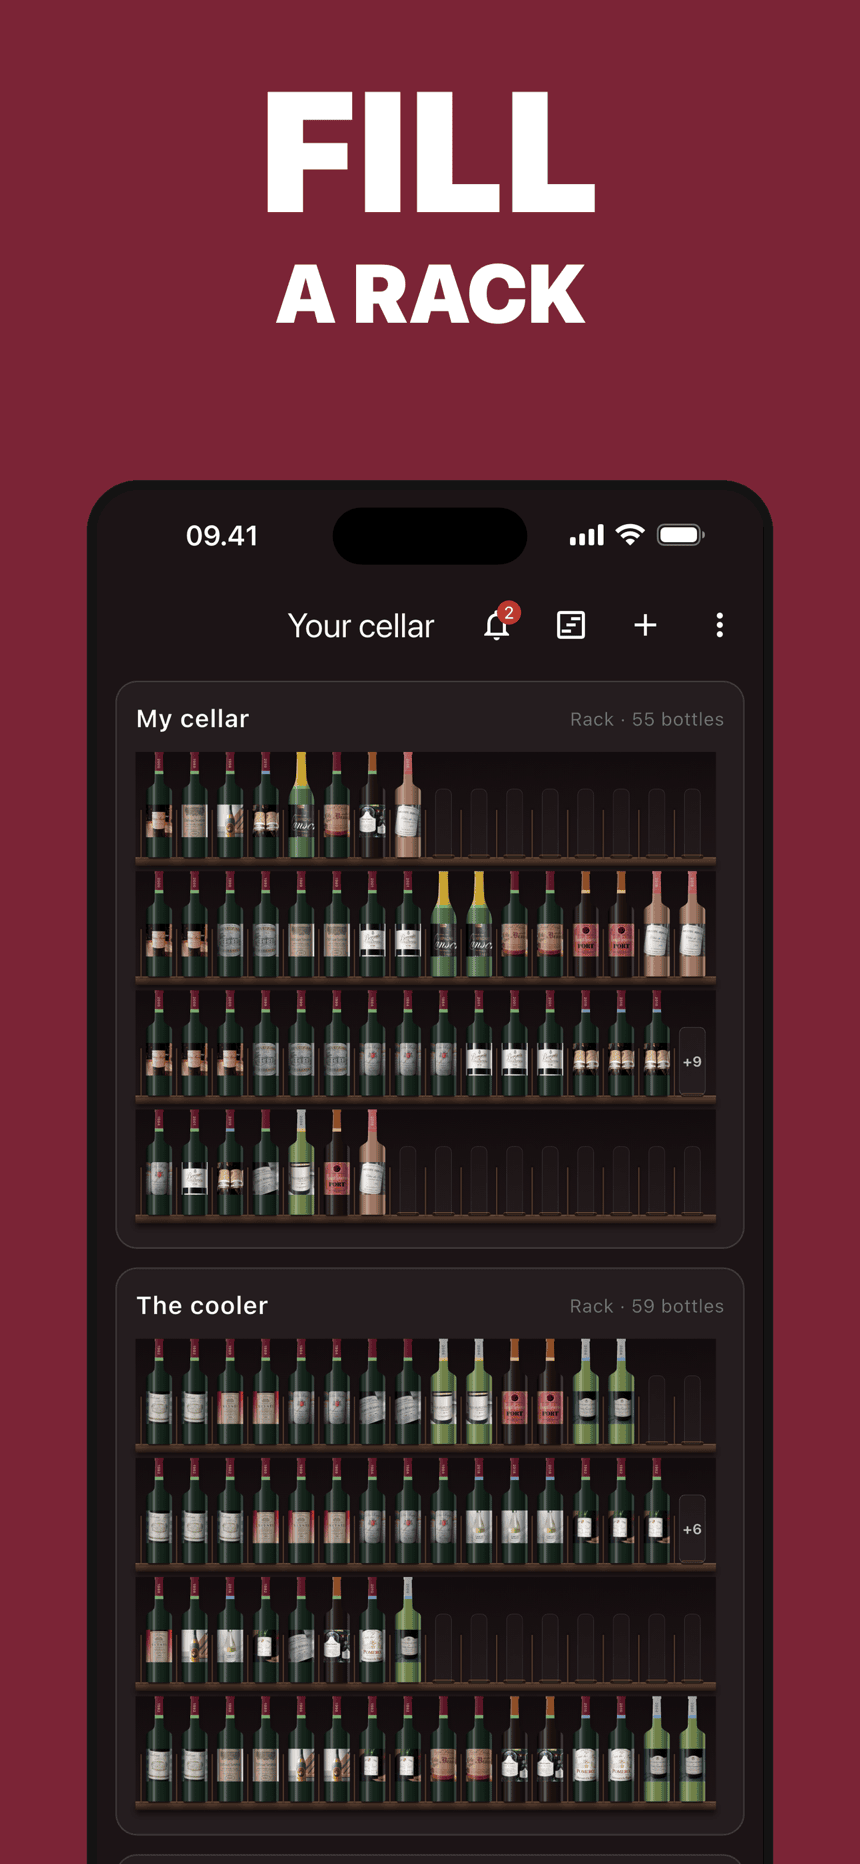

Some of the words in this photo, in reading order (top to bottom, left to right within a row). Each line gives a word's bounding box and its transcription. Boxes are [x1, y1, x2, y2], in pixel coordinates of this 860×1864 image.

[186, 525, 257, 547] 09.41
[504, 605, 514, 620] 2
[288, 613, 351, 639] Your
[359, 613, 435, 639] cellar
[138, 709, 172, 732] My
[181, 708, 249, 728] cellar
[571, 712, 614, 726] Rack
[633, 712, 654, 726] 55
[662, 712, 723, 726] bottles
[683, 1056, 702, 1067] +9
[136, 1295, 182, 1315] The
[191, 1295, 268, 1315] cooler
[571, 1299, 613, 1313] Rack
[632, 1299, 654, 1313] 59
[662, 1299, 723, 1313] bottles
[683, 1524, 701, 1535] +6
